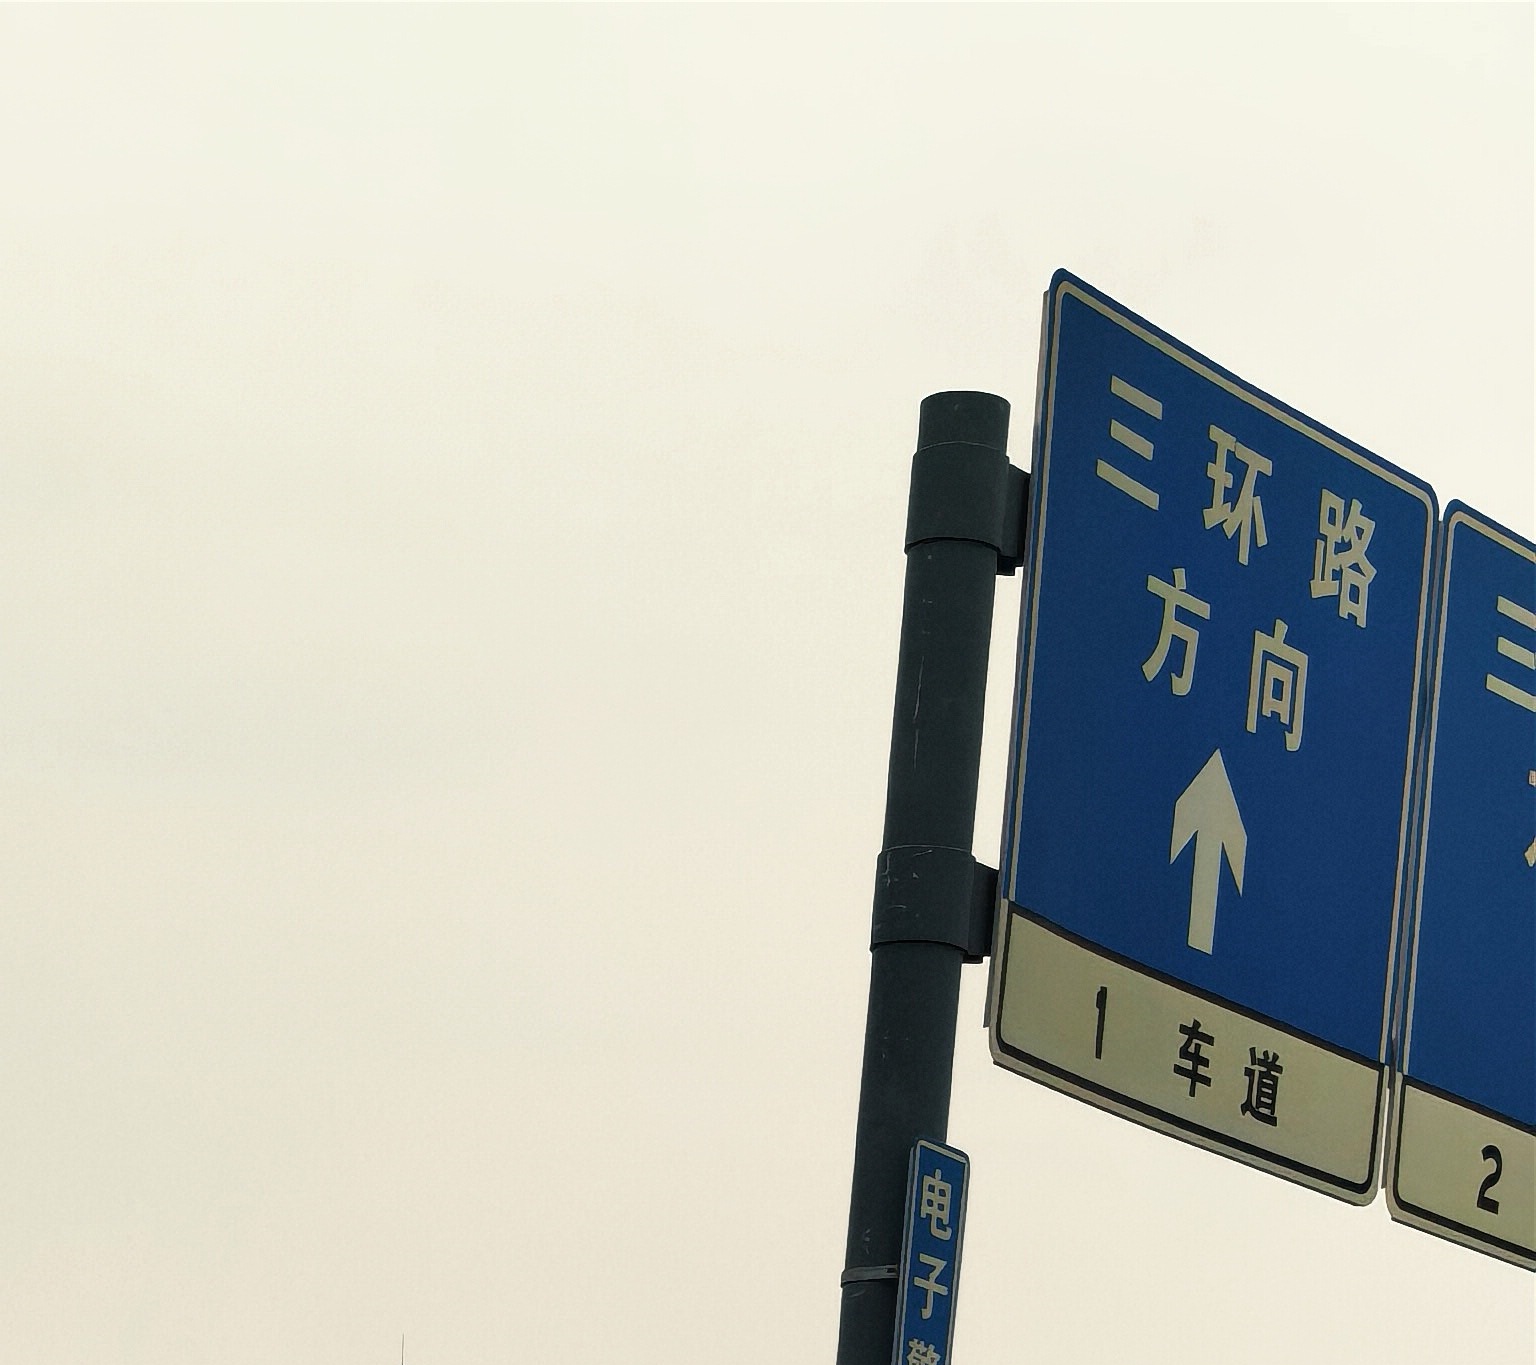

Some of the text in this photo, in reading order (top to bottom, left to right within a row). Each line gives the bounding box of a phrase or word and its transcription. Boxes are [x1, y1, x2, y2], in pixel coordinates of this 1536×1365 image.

[1097, 374, 1377, 627] 三环路
[1141, 568, 1309, 751] 方向
[1477, 1145, 1502, 1215] 2
